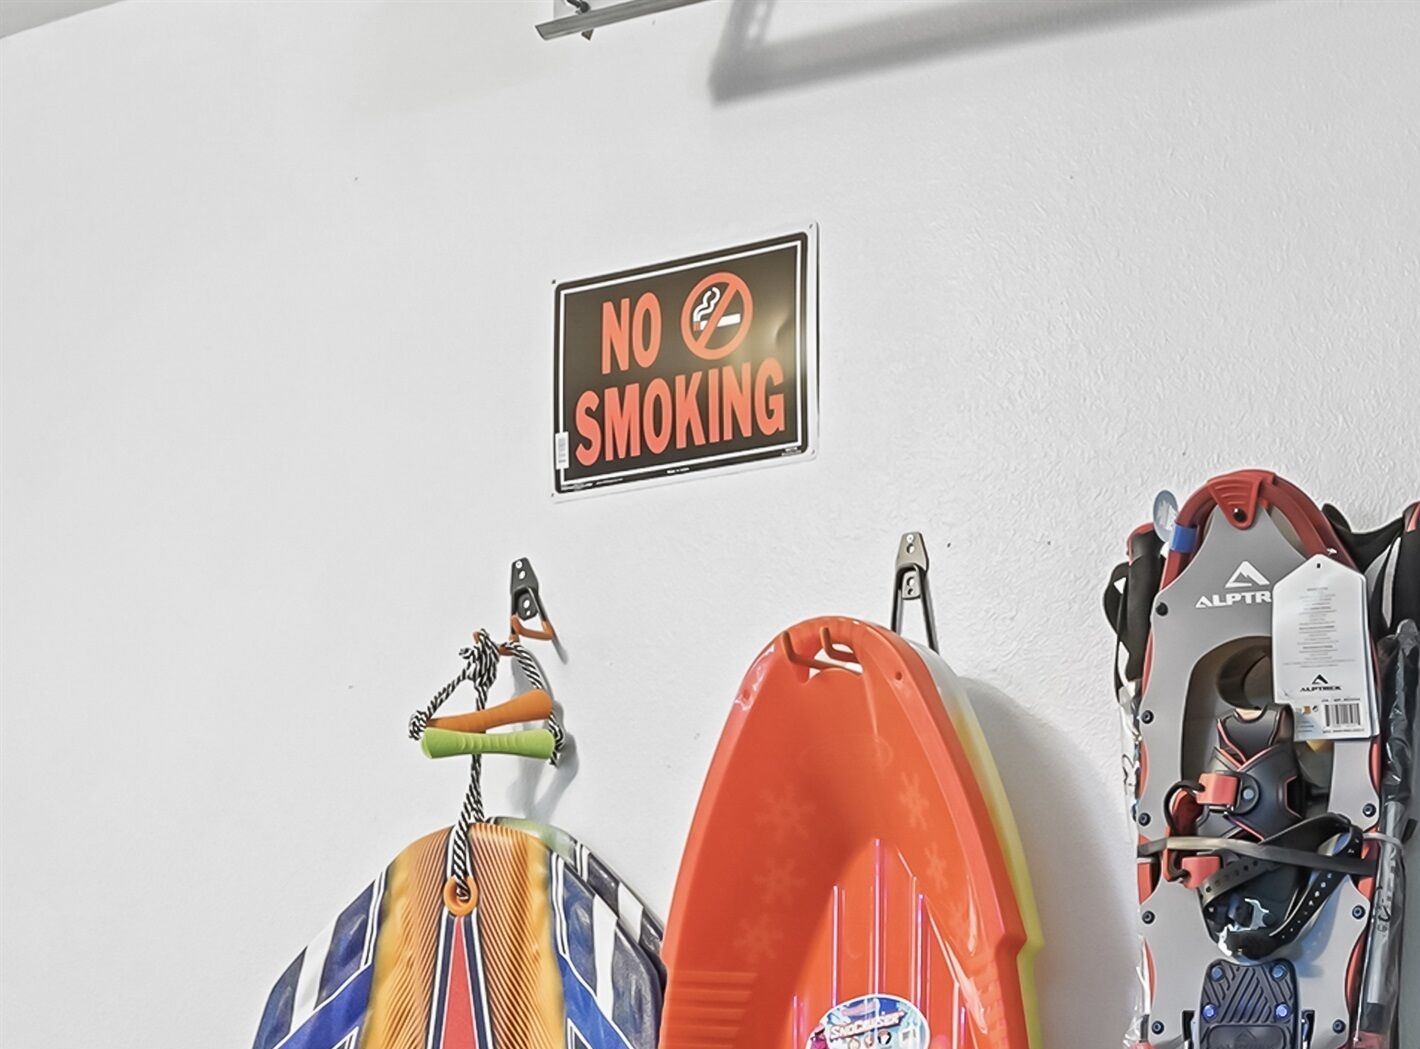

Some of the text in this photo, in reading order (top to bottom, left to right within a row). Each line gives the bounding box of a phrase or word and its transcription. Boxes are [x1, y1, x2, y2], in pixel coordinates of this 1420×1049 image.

[601, 292, 662, 375] NO
[575, 357, 785, 466] SMOKING
[1195, 591, 1272, 609] ALPTR
